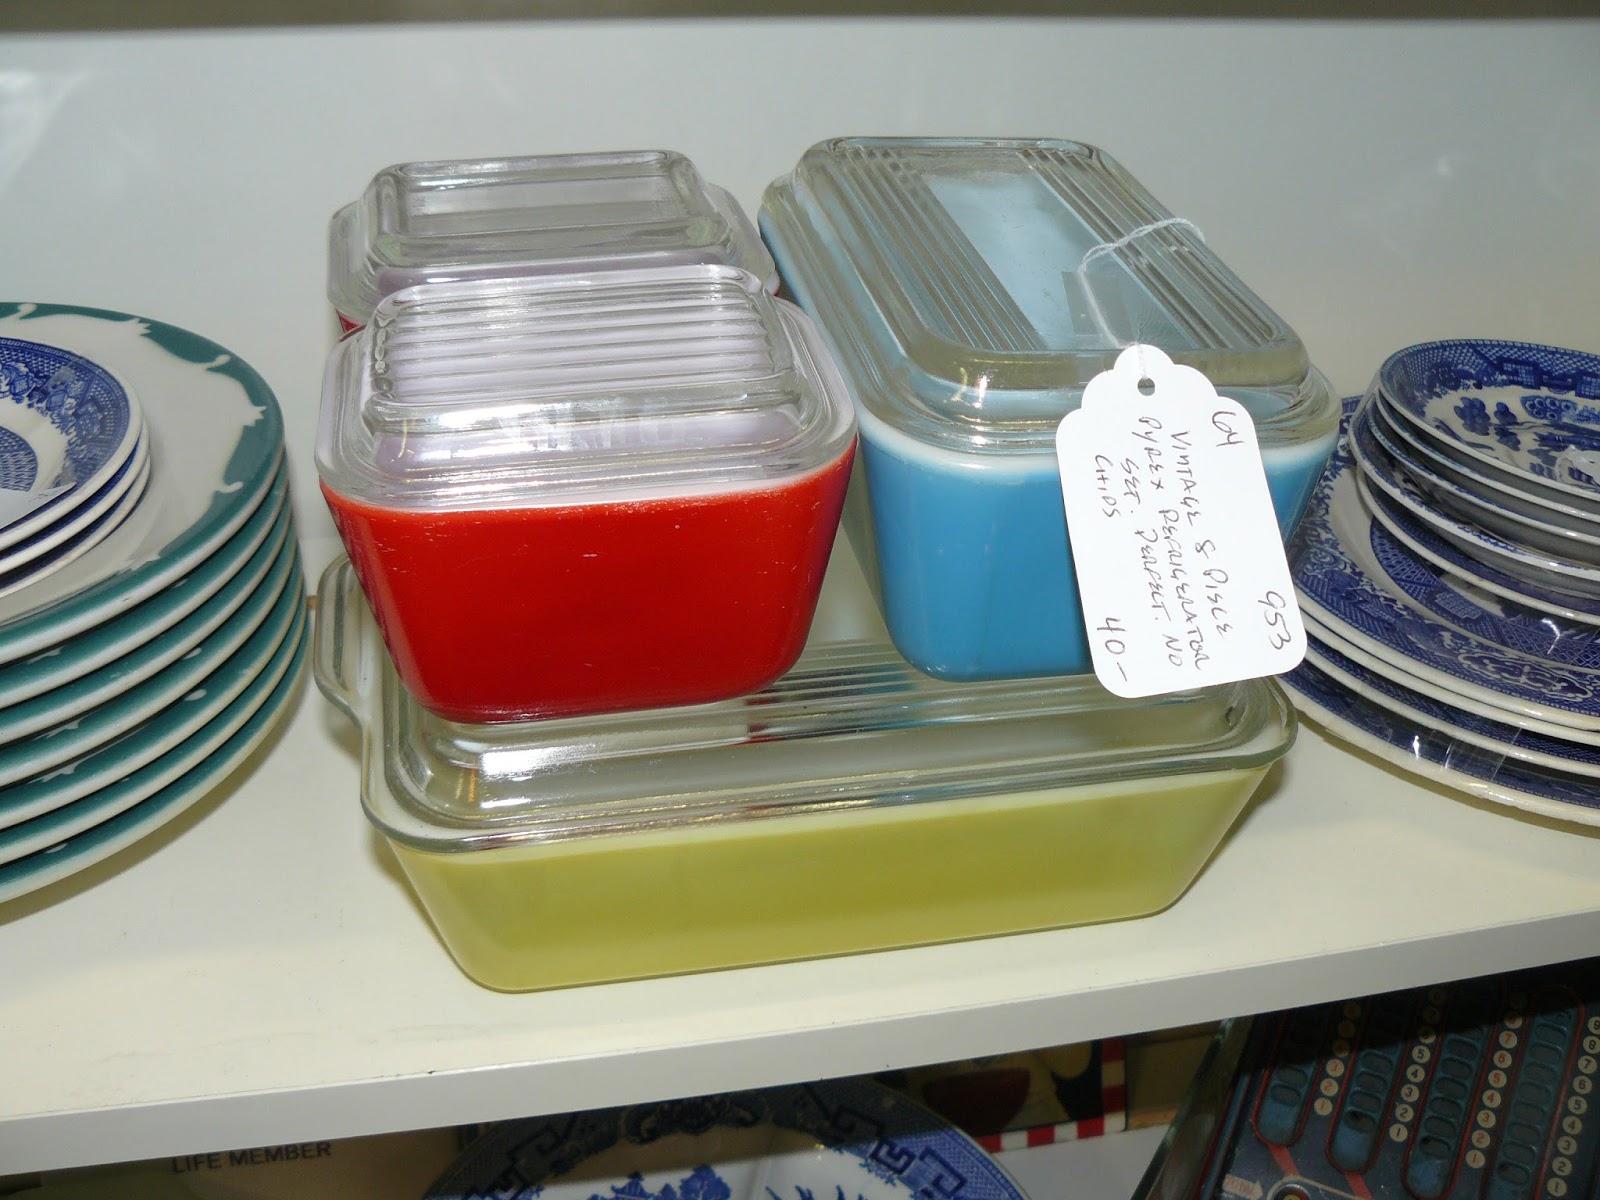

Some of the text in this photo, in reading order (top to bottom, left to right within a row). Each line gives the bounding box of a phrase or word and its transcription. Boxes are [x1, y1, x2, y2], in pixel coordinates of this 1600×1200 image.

[1211, 410, 1244, 447] 64
[1131, 416, 1165, 490] PYREX
[1095, 454, 1121, 518] CHIPS
[1257, 590, 1292, 650] 953
[1162, 633, 1183, 667] NO
[171, 1141, 332, 1174] LIFE MEMBER
